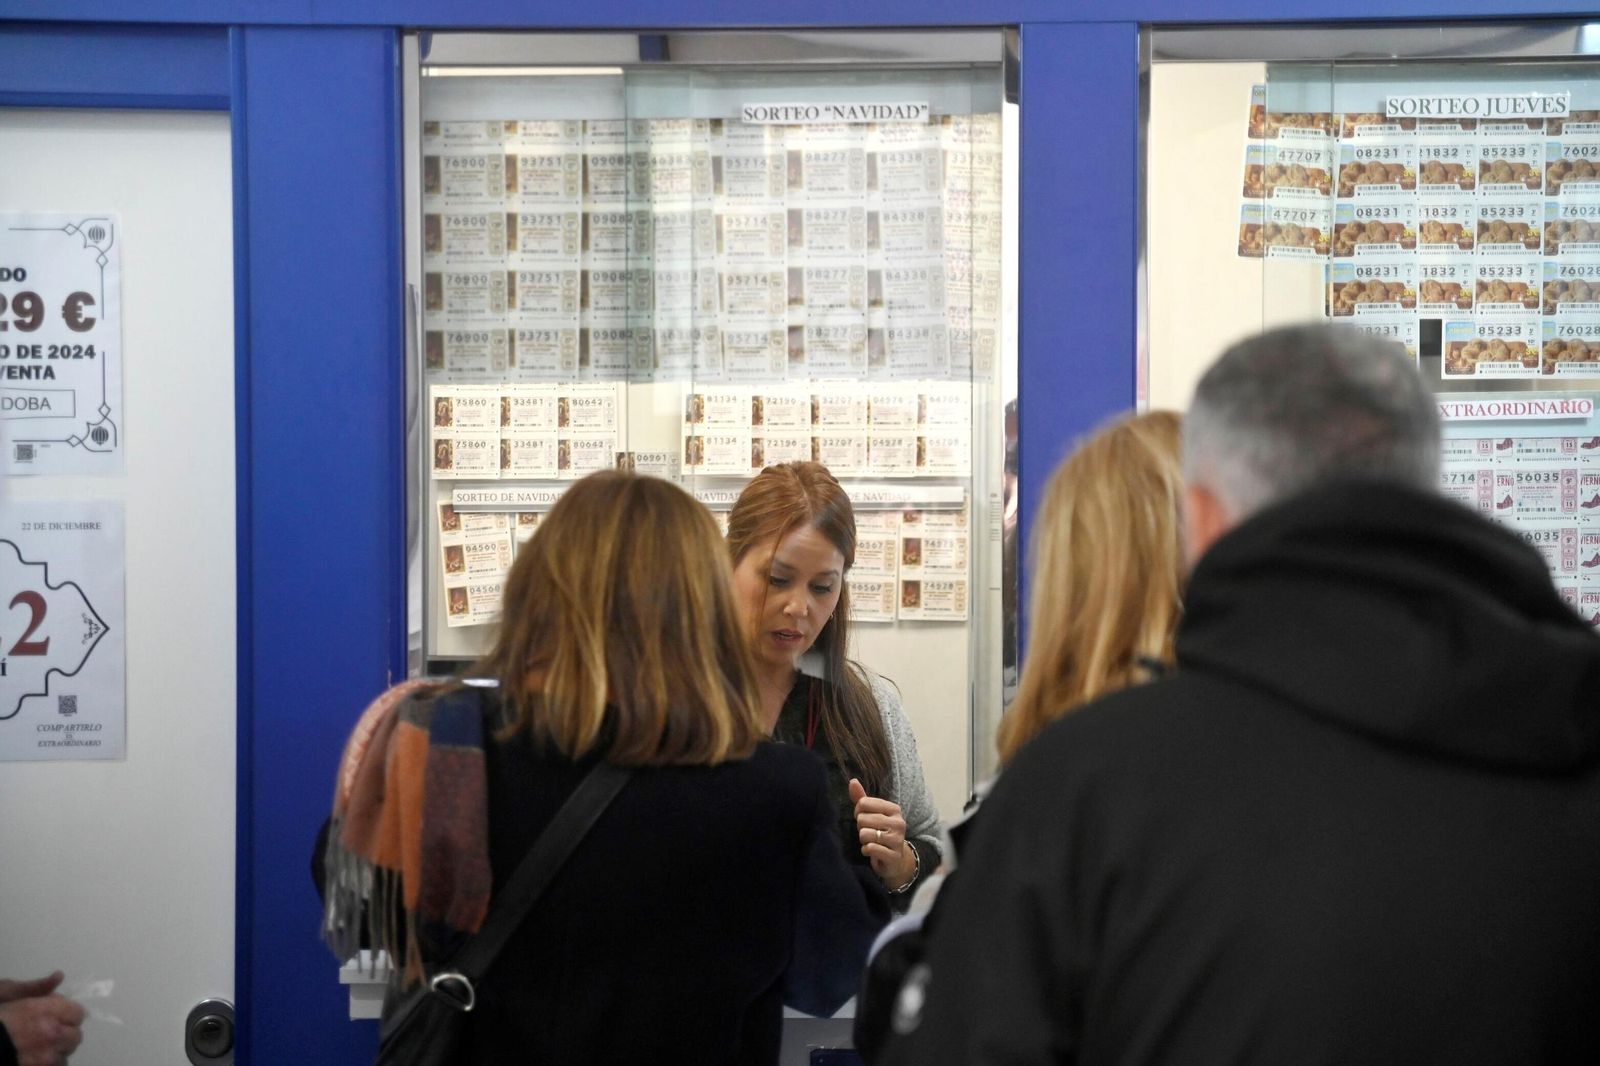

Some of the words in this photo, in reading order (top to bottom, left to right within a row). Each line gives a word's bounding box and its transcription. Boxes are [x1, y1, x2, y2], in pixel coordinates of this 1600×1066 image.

[1387, 98, 1480, 116] SORTEO
[1483, 97, 1566, 117] JUEVES
[743, 104, 820, 121] SORTEO
[1278, 150, 1321, 161] 47707
[1356, 148, 1398, 158] 08231
[1482, 147, 1525, 156] 85233
[444, 158, 486, 168] 76900
[520, 157, 561, 167] 93751
[1273, 210, 1316, 220] 47707
[1356, 208, 1398, 217] 08231
[1419, 208, 1457, 217] 1832
[1481, 207, 1524, 216] 85233
[445, 216, 487, 226] 76900
[520, 215, 561, 226] 93751
[0, 267, 27, 283] DO
[1356, 267, 1398, 276] 08231
[1479, 266, 1522, 276] 85233
[520, 273, 560, 283] 93751
[61, 291, 97, 333] €
[1478, 326, 1522, 335] 85233
[447, 333, 489, 343] 76900
[519, 331, 559, 341] 93751
[16, 344, 43, 359] DE
[47, 344, 96, 360] 2024
[0, 397, 52, 411] DOBA
[1440, 400, 1592, 418] XTRAORDINARIO
[1516, 473, 1559, 482] 56035
[456, 492, 498, 502] SORTEO
[501, 492, 514, 502] DE
[21, 522, 31, 531] 22
[34, 522, 47, 531] DE
[48, 521, 102, 531] DICIEMBRE
[36, 723, 103, 733] COMPARTIRLO
[37, 740, 102, 748] EXTRAORDINARIO
